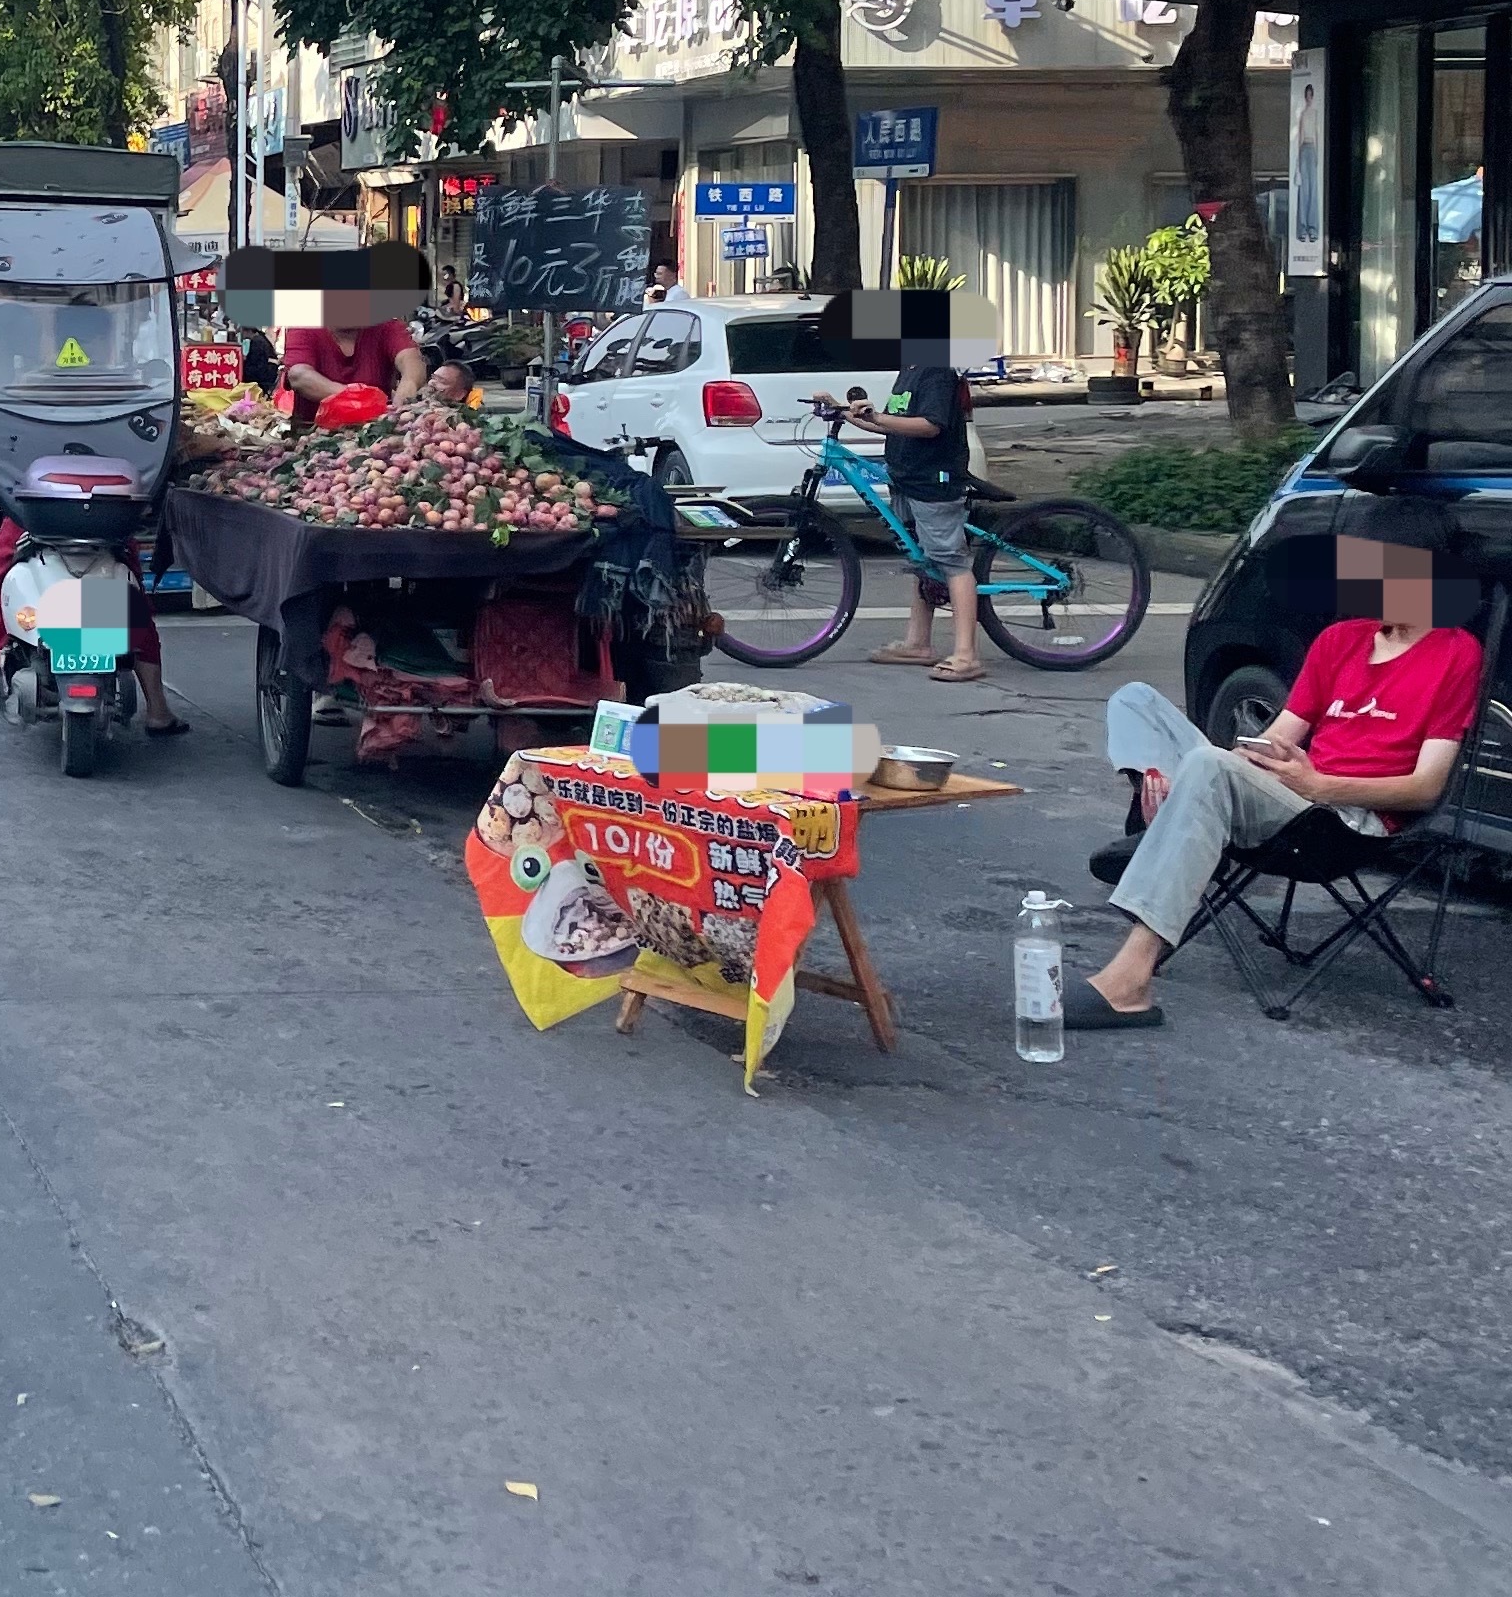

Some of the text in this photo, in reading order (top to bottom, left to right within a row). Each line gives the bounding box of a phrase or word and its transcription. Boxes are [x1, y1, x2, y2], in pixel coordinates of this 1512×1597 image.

[708, 188, 783, 203] 铁西路
[188, 349, 239, 368] 手撕鸡
[188, 369, 239, 388] 荷叶鸡
